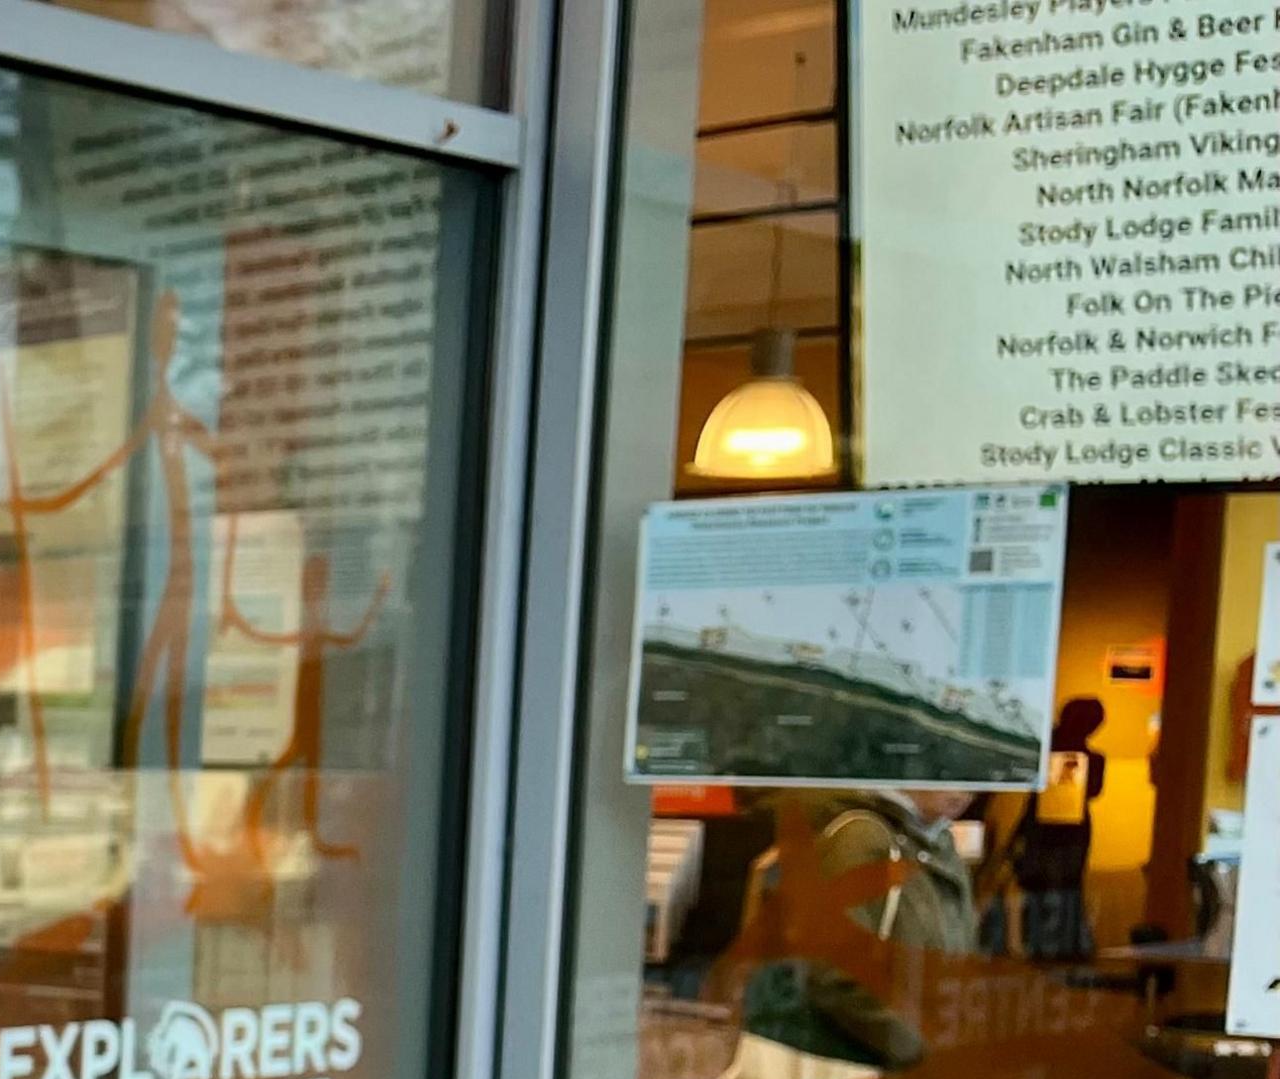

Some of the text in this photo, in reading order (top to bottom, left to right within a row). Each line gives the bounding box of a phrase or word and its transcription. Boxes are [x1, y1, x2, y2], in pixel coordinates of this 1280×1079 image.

[893, 0, 1040, 32] Mundesley
[959, 30, 1104, 63] Fakenham
[1112, 20, 1159, 46] Gin
[1169, 17, 1186, 41] &
[1198, 13, 1264, 38] Beer
[996, 63, 1125, 97] Deepdale
[1134, 58, 1225, 87] Hygge
[895, 113, 995, 146] Norfolk
[1002, 106, 1103, 136] Artisan
[1112, 97, 1165, 124] Fair
[1011, 139, 1181, 172] Sheringham
[1037, 179, 1114, 208] North
[1123, 171, 1228, 201] Norfolk
[1018, 217, 1099, 248] Stody
[1105, 211, 1192, 242] Lodge
[1005, 257, 1082, 285] North
[1090, 250, 1220, 279] Walsham
[1066, 291, 1126, 318] Folk
[1134, 289, 1172, 314] On
[1180, 286, 1234, 312] The
[997, 330, 1099, 359] Norfolk
[1108, 328, 1127, 352] &
[1135, 323, 1253, 352] Norwich
[1049, 367, 1102, 393] The
[1110, 362, 1208, 390] Paddle
[1018, 402, 1085, 430] Crab
[1093, 402, 1111, 427] &
[1120, 400, 1227, 426] Lobster
[980, 441, 1058, 472] Stody
[1065, 438, 1150, 469] Lodge
[1159, 435, 1263, 461] Classic
